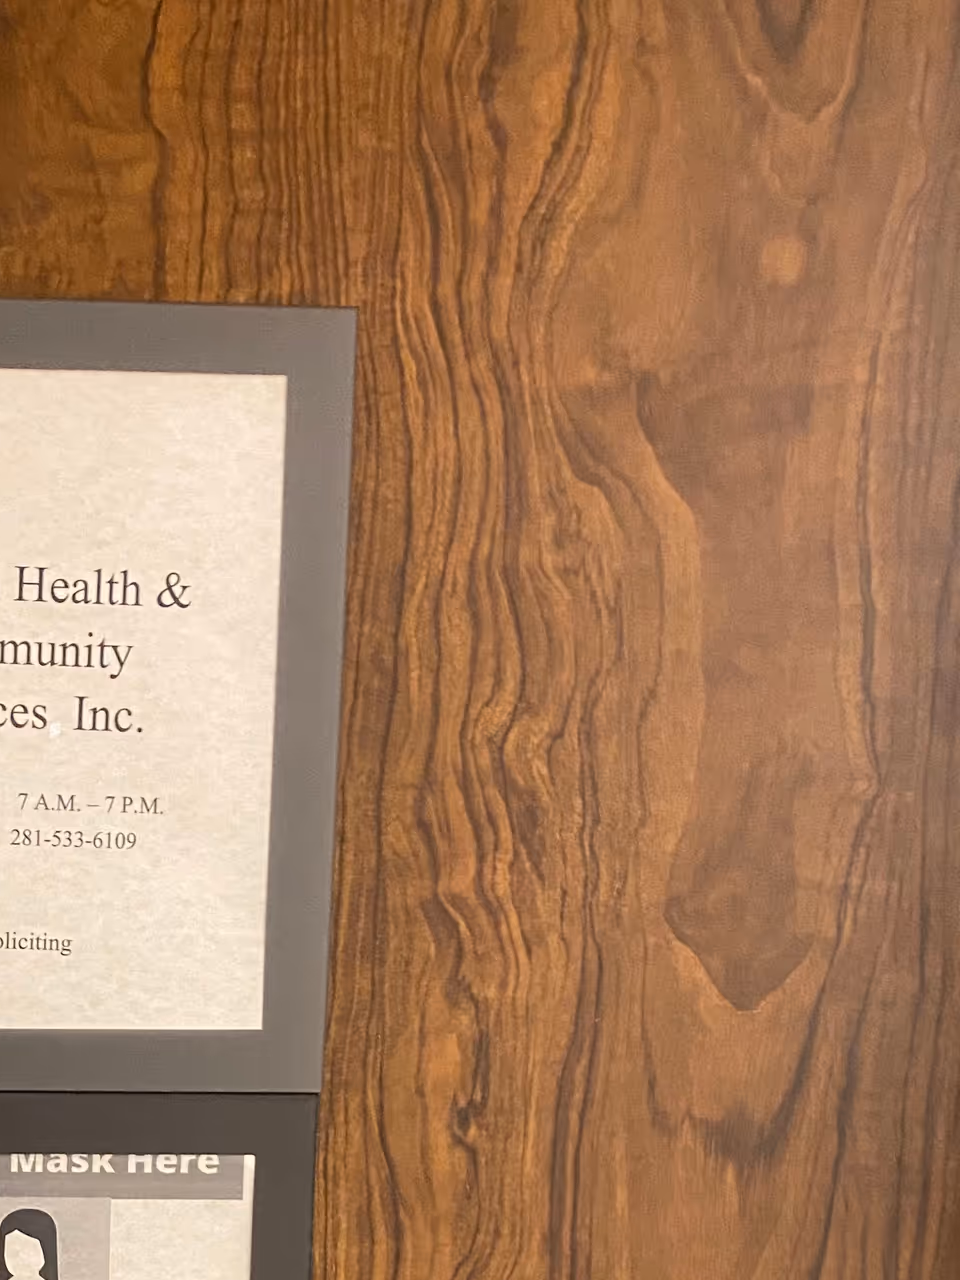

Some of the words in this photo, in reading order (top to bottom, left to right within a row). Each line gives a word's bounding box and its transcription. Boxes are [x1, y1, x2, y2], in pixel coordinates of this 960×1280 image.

[14, 565, 142, 607] Health
[156, 572, 191, 609] &
[73, 695, 143, 733] Inc.
[18, 792, 29, 810] 7
[33, 793, 81, 812] A.M.
[105, 795, 116, 813] 7
[122, 796, 165, 816] P.M.
[10, 828, 137, 849] 281-533-6109
[10, 1153, 116, 1174] Mask
[127, 1154, 221, 1175] Here
